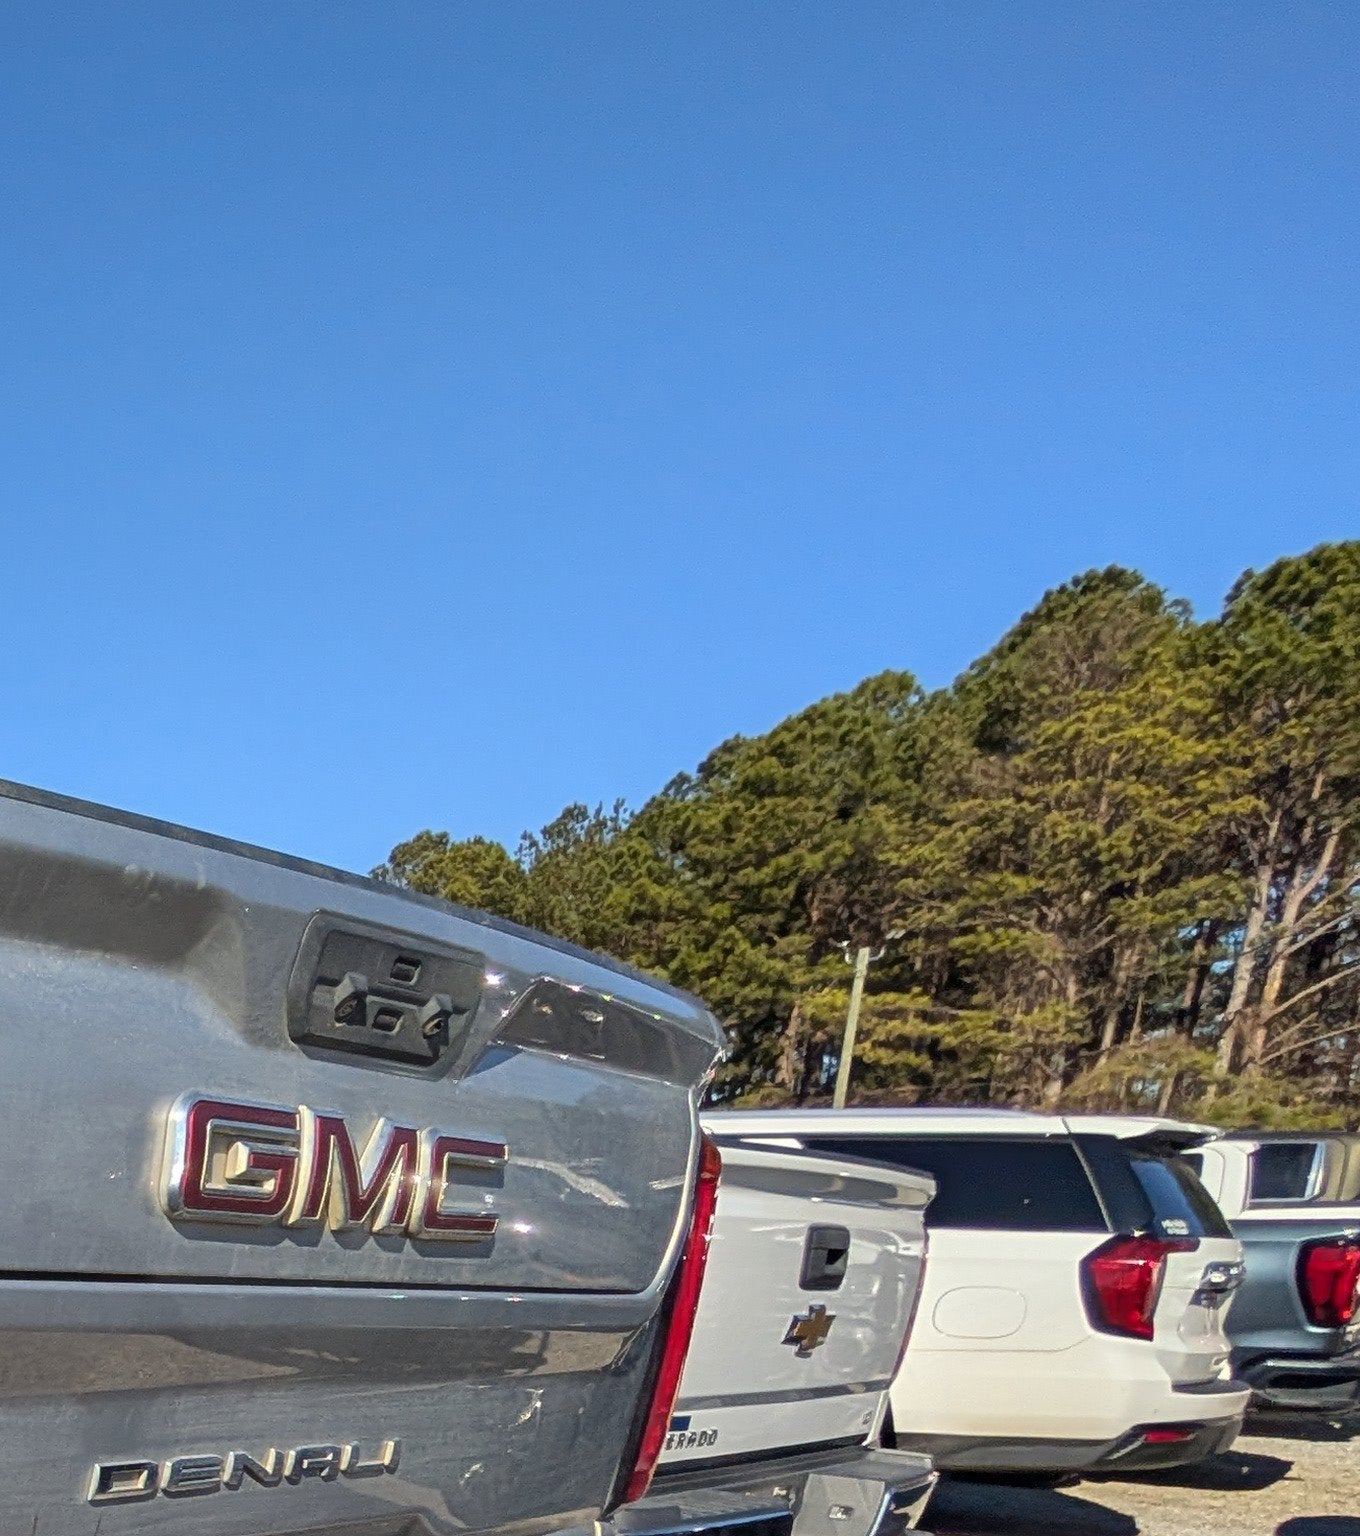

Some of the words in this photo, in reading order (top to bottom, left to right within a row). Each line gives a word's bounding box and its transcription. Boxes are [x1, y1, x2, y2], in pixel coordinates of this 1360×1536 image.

[160, 1091, 509, 1242] GMC
[86, 1438, 401, 1504] DENALI
[664, 1428, 719, 1451] ERADO
